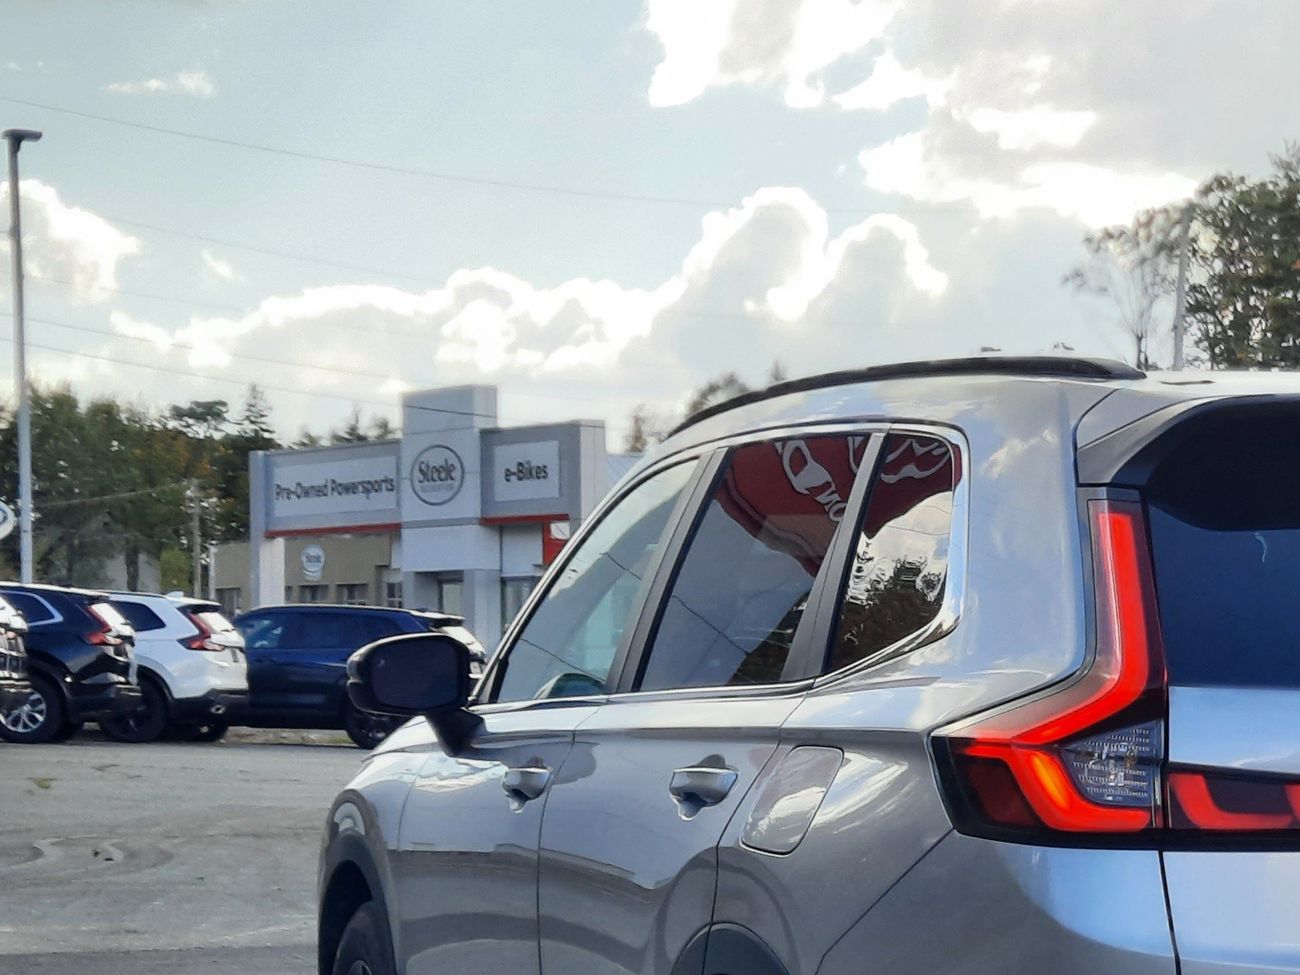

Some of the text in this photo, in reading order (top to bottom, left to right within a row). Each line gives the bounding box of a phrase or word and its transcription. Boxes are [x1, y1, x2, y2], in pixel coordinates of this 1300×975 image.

[418, 459, 458, 484] Steele
[504, 460, 549, 482] e-Bikes
[275, 476, 395, 501] Pre-Owned Powersports
